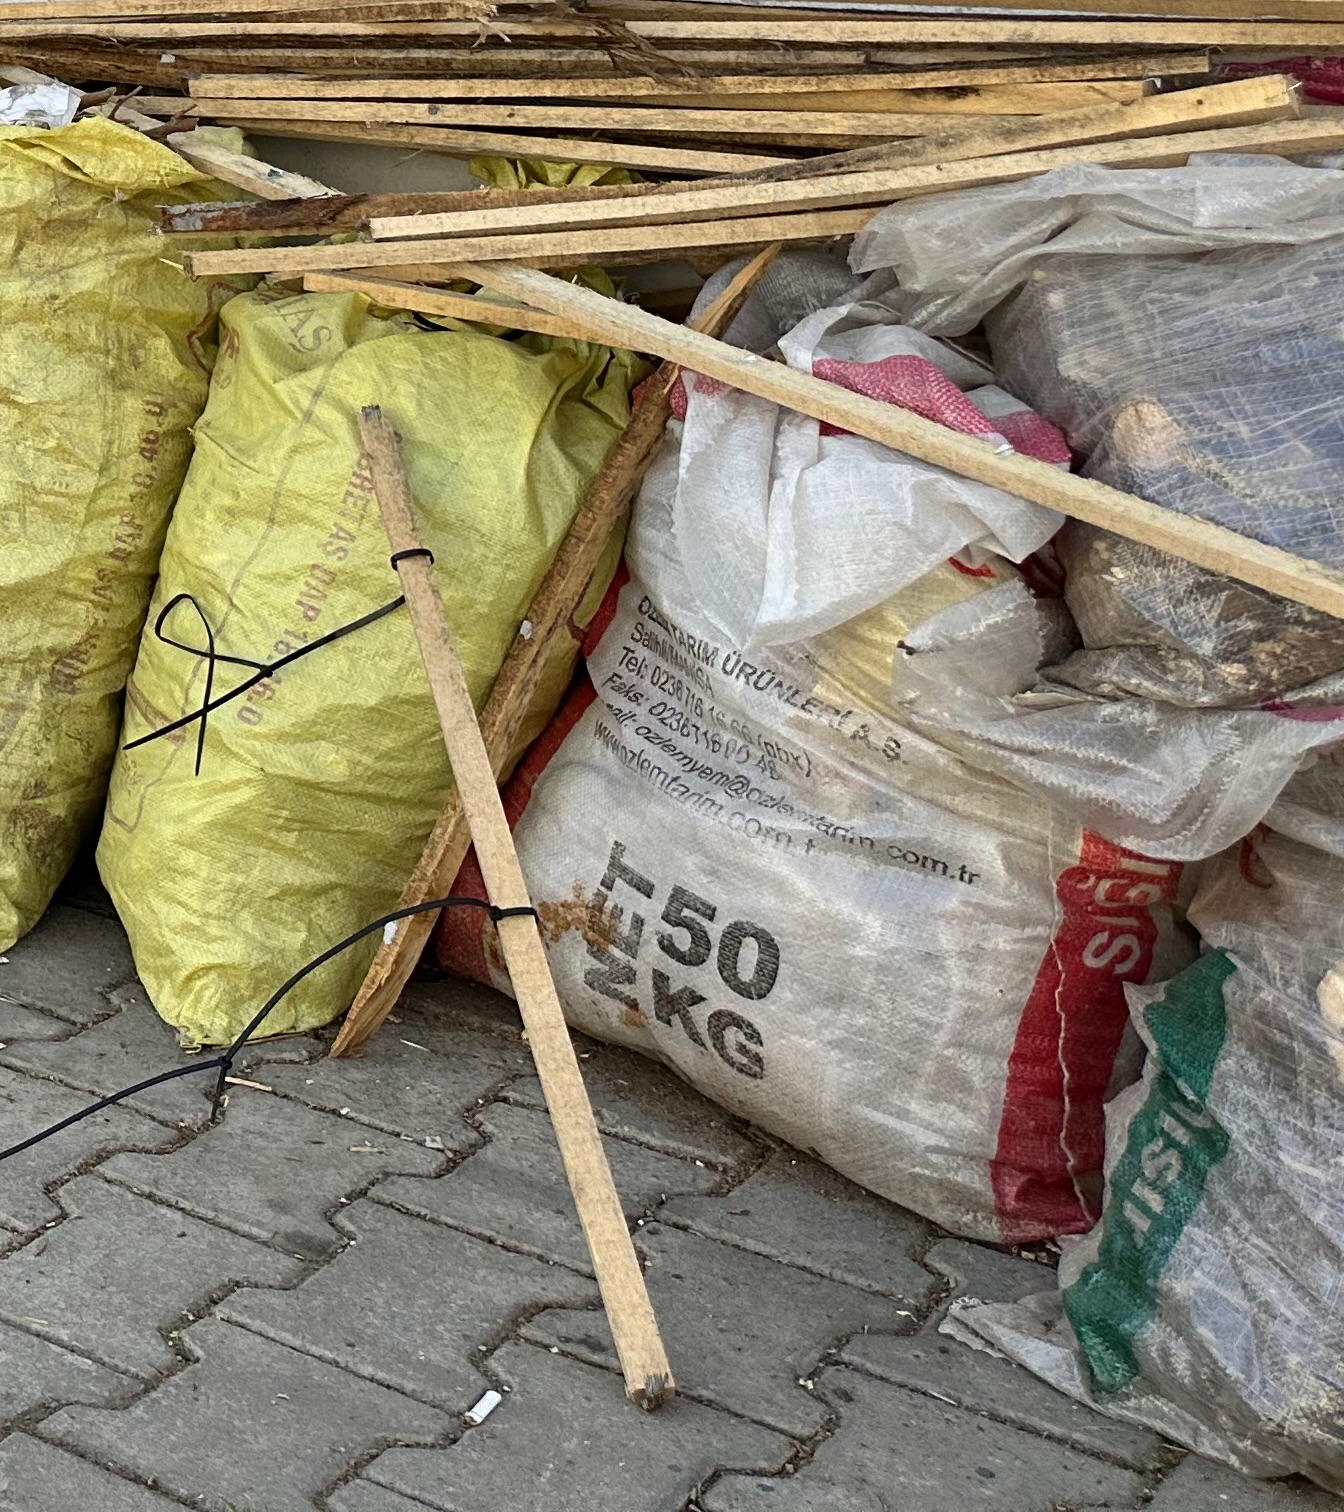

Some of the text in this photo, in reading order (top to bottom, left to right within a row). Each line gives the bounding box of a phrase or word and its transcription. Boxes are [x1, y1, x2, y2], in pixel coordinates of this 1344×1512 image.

[295, 563, 337, 622] DAP
[618, 645, 649, 680] Tel:
[654, 883, 781, 1002] 50
[650, 967, 765, 1081] KG
